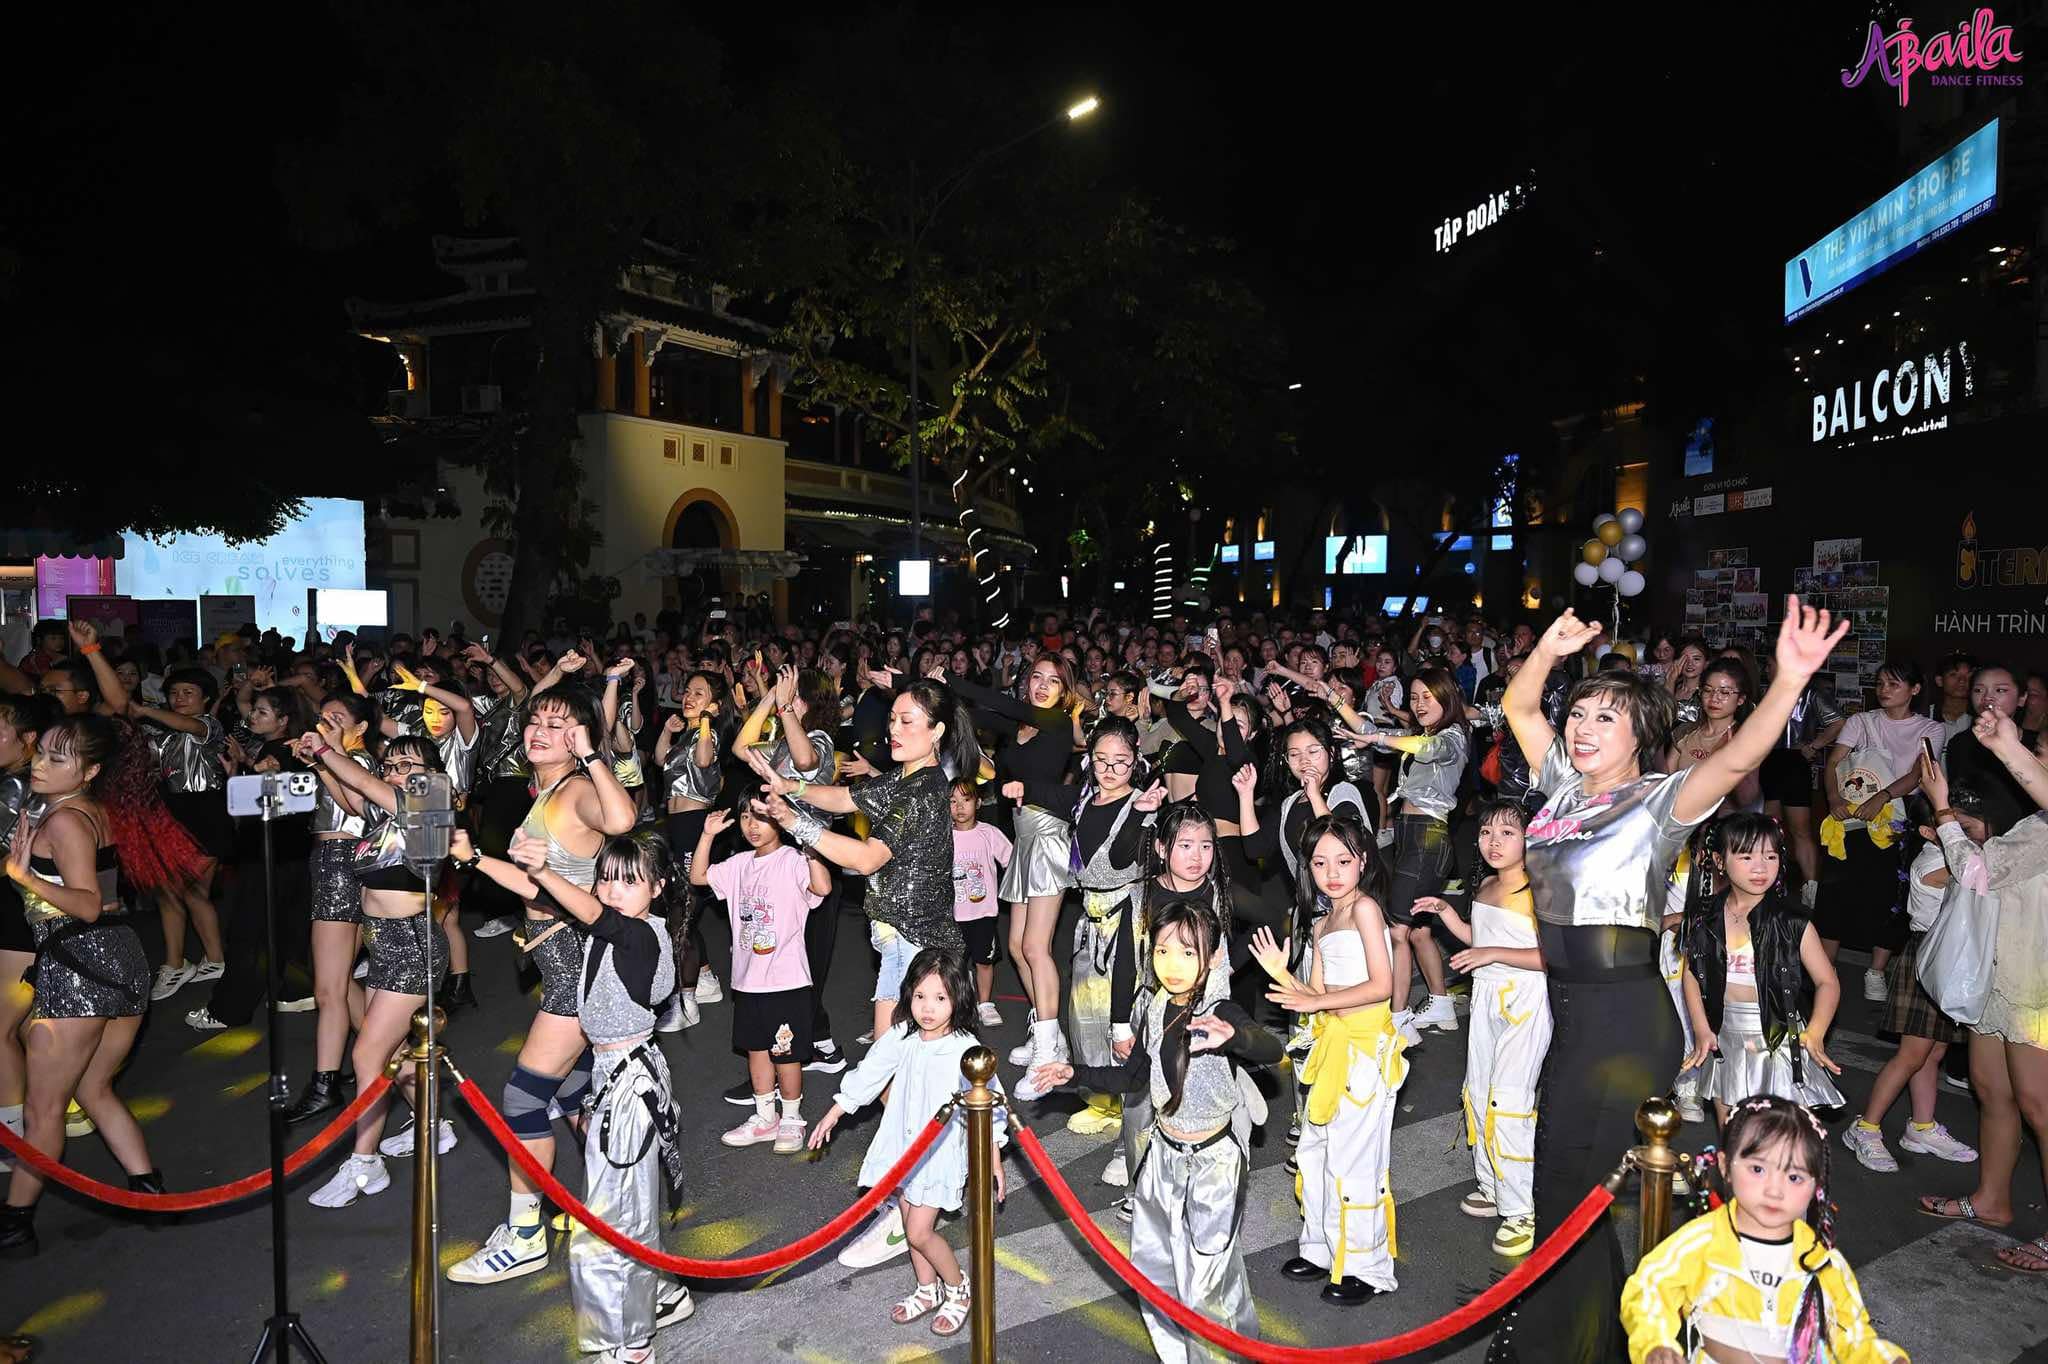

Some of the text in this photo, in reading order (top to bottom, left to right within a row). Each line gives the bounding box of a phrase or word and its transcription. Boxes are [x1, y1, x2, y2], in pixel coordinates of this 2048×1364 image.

[1824, 235, 1846, 265] THE
[1849, 195, 1904, 246] VITAMIN
[1908, 152, 1972, 210] SHOPPE
[1434, 217, 1462, 253] TẬP
[238, 560, 330, 582] solves
[283, 555, 355, 570] everything
[1935, 610, 1991, 633] HÀNH
